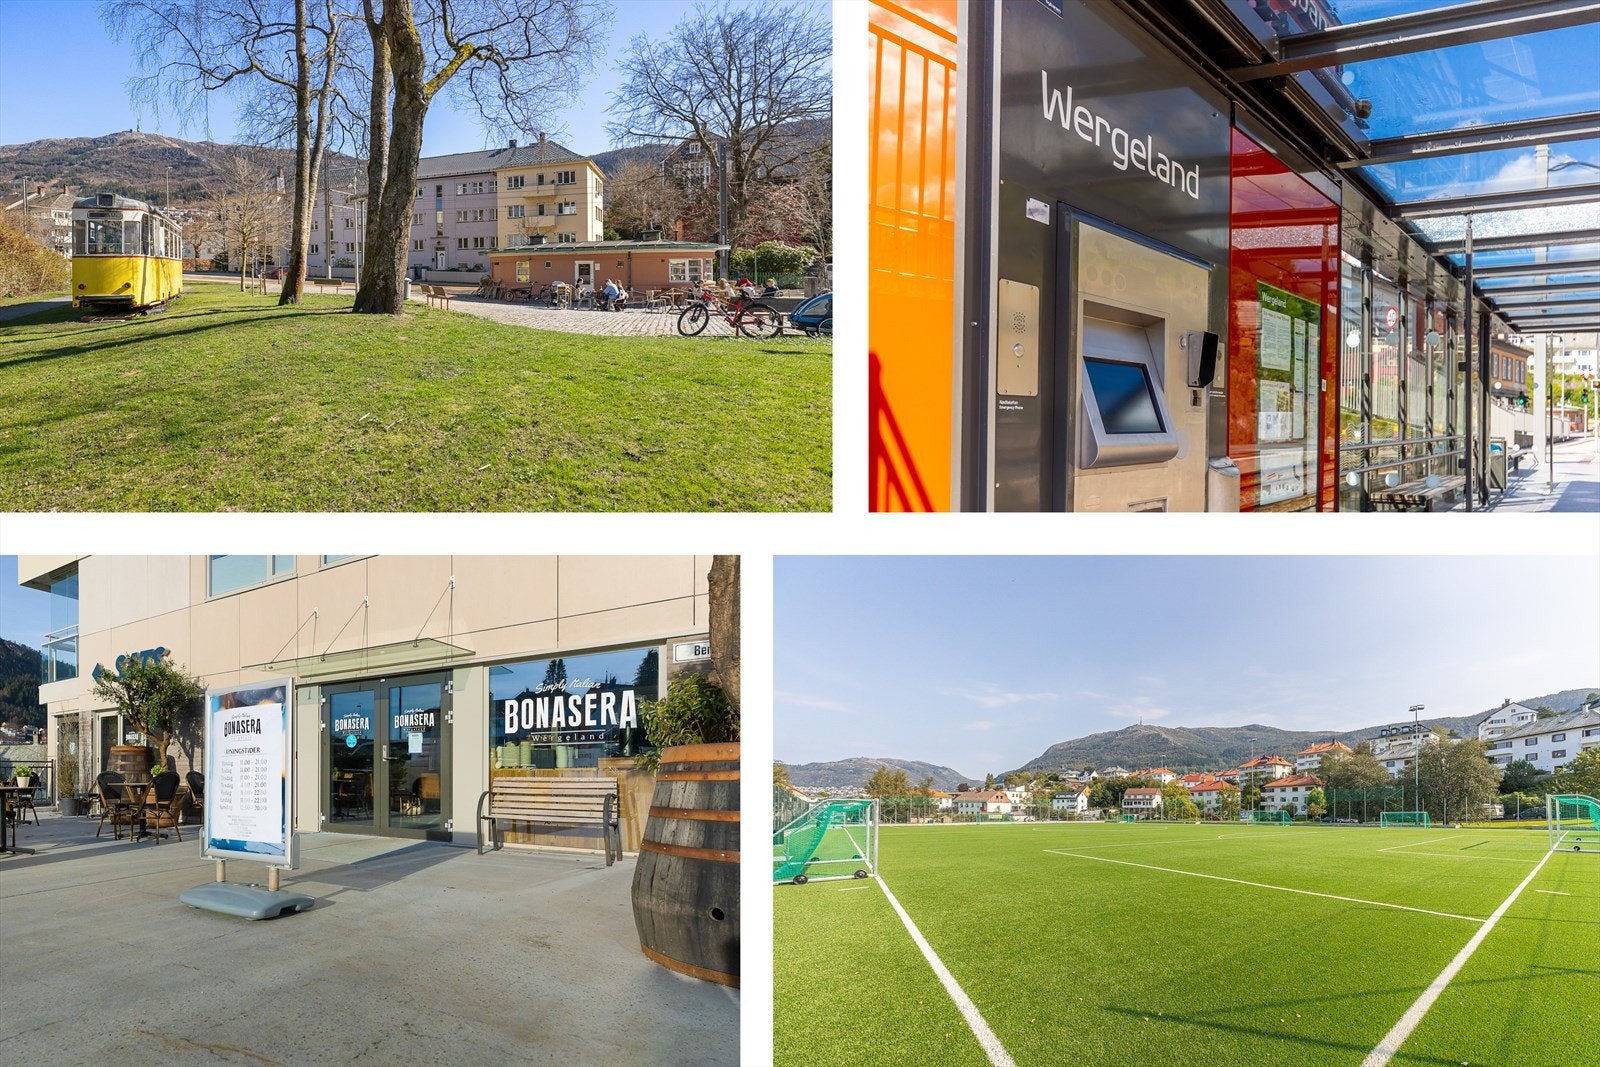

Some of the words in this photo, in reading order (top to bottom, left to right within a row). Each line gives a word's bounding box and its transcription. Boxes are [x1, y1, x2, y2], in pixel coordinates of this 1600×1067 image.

[1042, 69, 1200, 200] Wergeland
[535, 678, 567, 694] Simply
[568, 677, 602, 689] Italian
[505, 690, 638, 734] BONASERA
[224, 718, 262, 737] BONASERA
[334, 717, 370, 732] BONASERA
[394, 713, 435, 729] BONASERA
[531, 732, 606, 742] Wergeland
